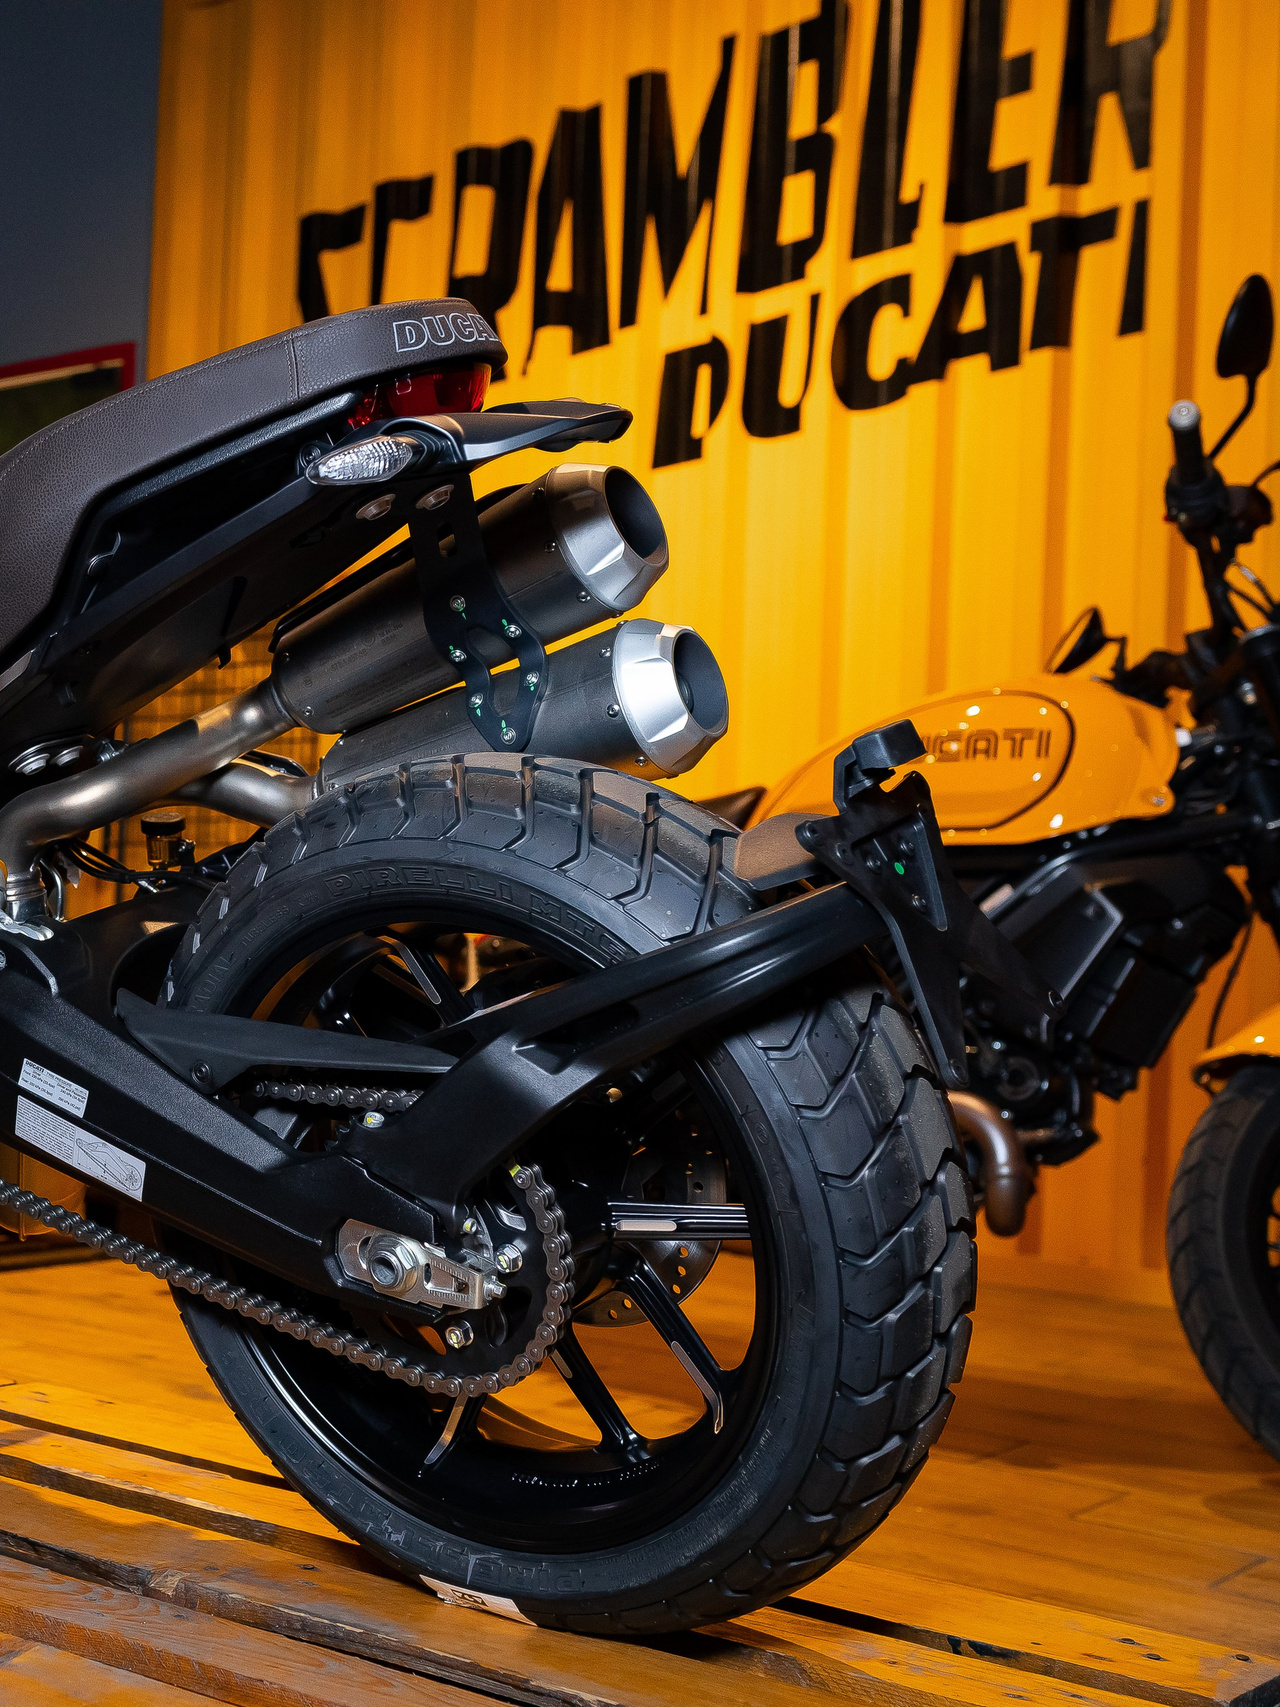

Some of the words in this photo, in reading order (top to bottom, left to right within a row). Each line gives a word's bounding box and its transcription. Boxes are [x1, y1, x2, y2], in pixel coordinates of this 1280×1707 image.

[393, 312, 501, 352] DUCA
[652, 198, 1151, 470] DUCATI
[921, 727, 1052, 763] CATI
[324, 865, 513, 902] PIRELLI
[530, 892, 627, 962] MT6
[25, 1060, 45, 1073] DUCATI
